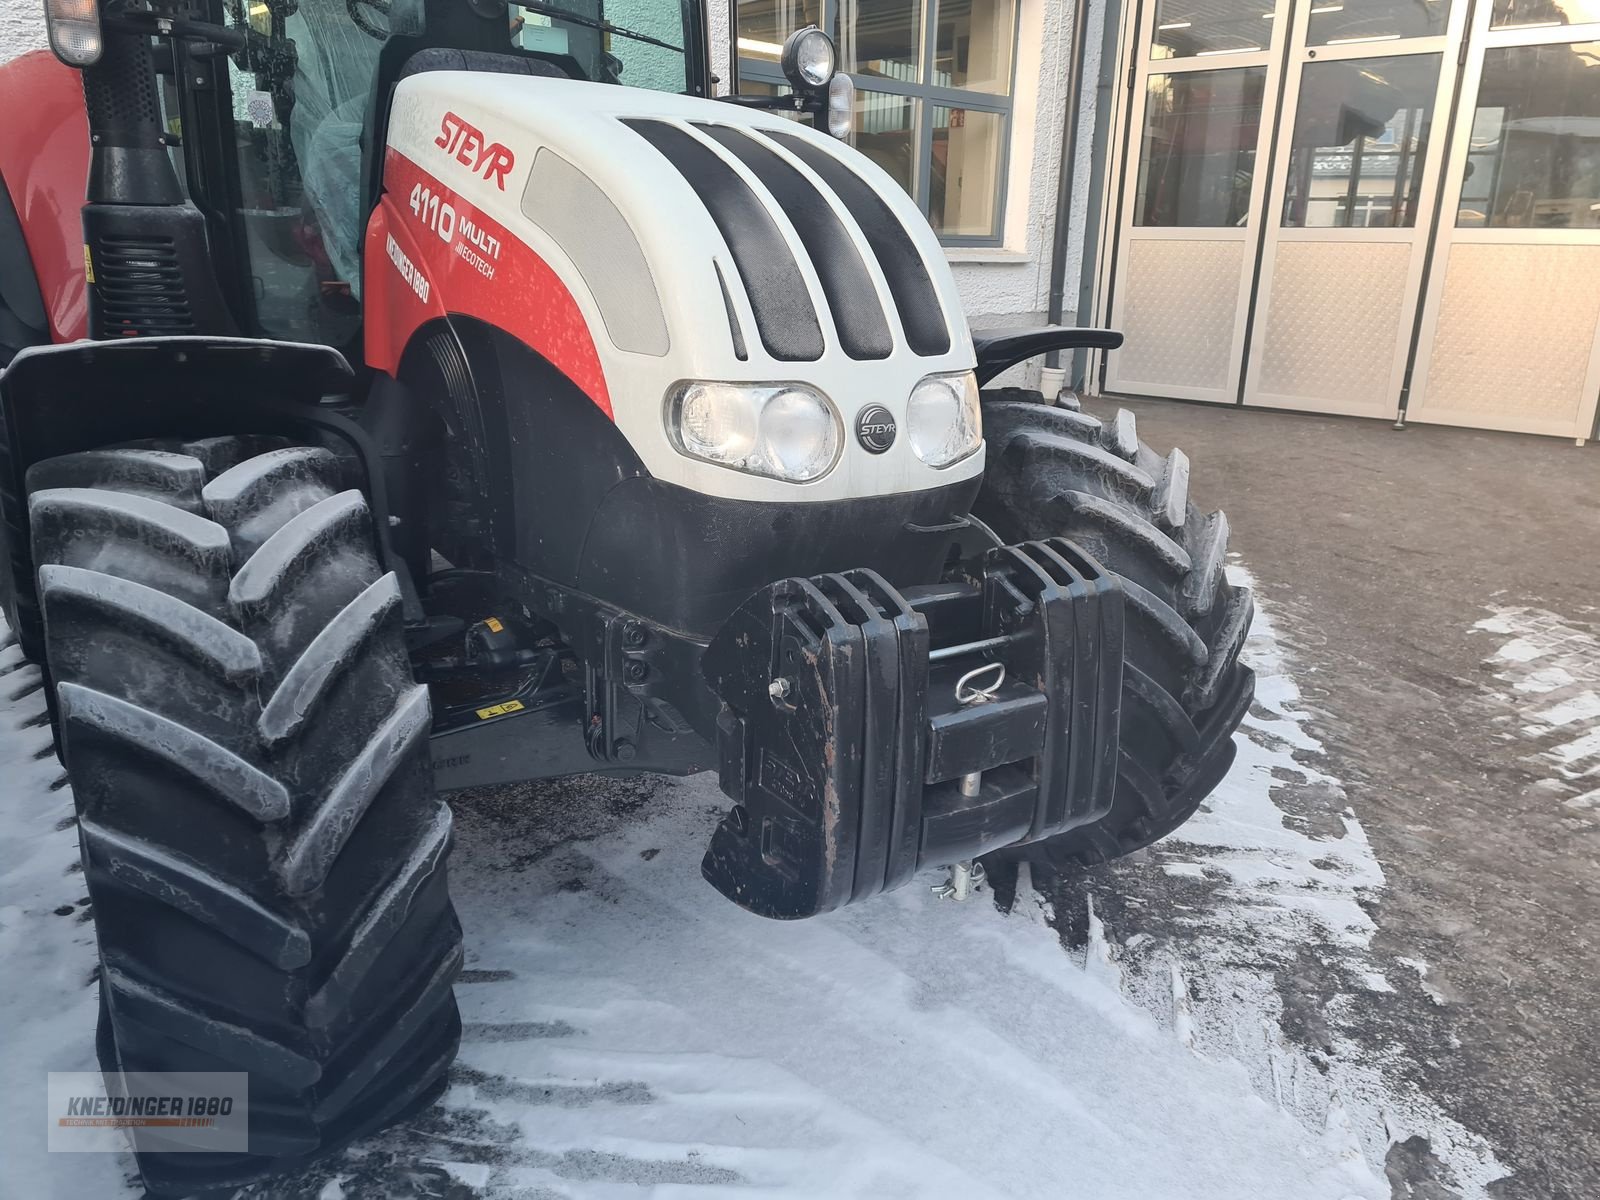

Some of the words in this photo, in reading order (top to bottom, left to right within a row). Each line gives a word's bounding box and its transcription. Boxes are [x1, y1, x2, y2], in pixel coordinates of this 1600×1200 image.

[434, 111, 515, 192] STEYR
[409, 182, 456, 244] 4110
[458, 215, 501, 261] MULTI
[412, 267, 430, 304] 1880
[860, 423, 896, 435] STEYR
